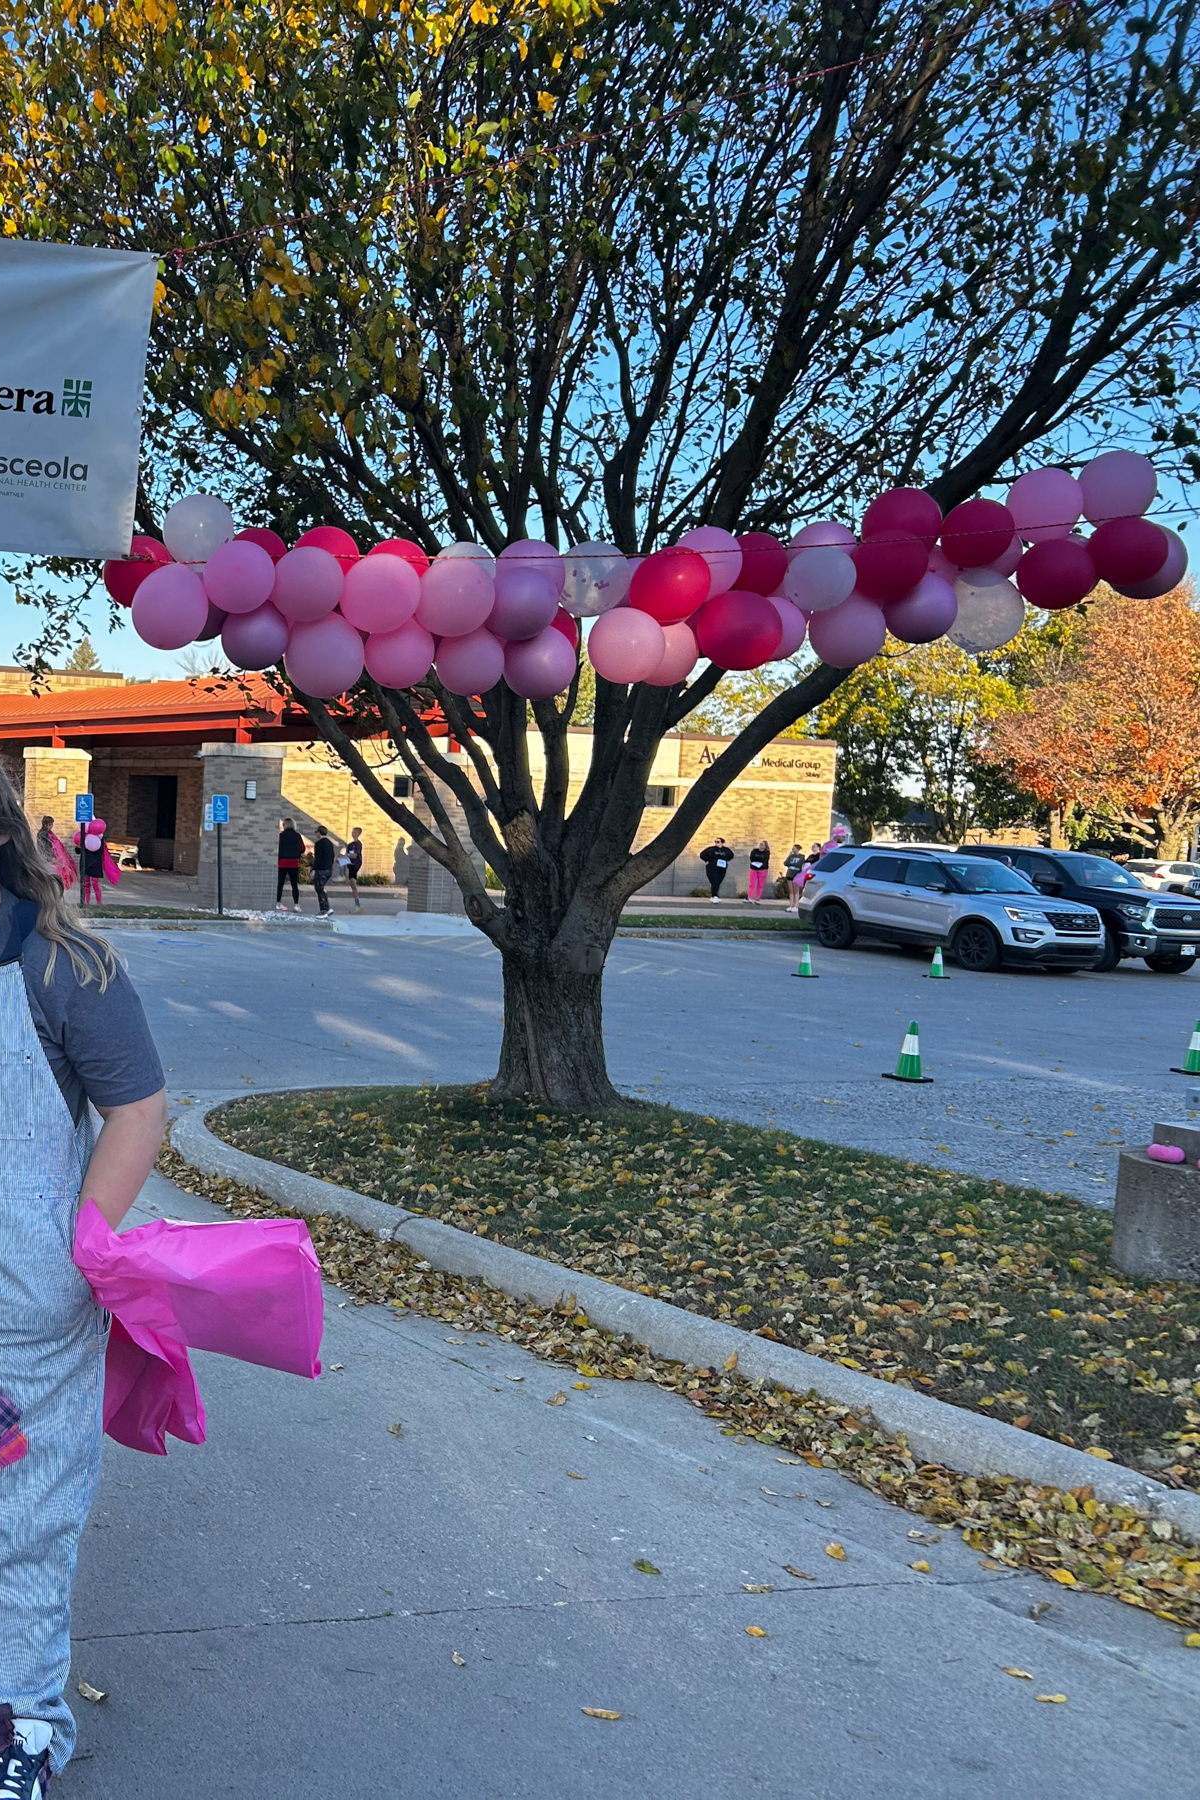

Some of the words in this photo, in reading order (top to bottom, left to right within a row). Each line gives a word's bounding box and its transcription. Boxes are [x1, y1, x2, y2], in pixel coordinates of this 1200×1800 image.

[16, 478, 51, 489] HEALTH
[52, 481, 87, 492] CENTER
[761, 757, 795, 769] Medical
[794, 760, 822, 771] Group
